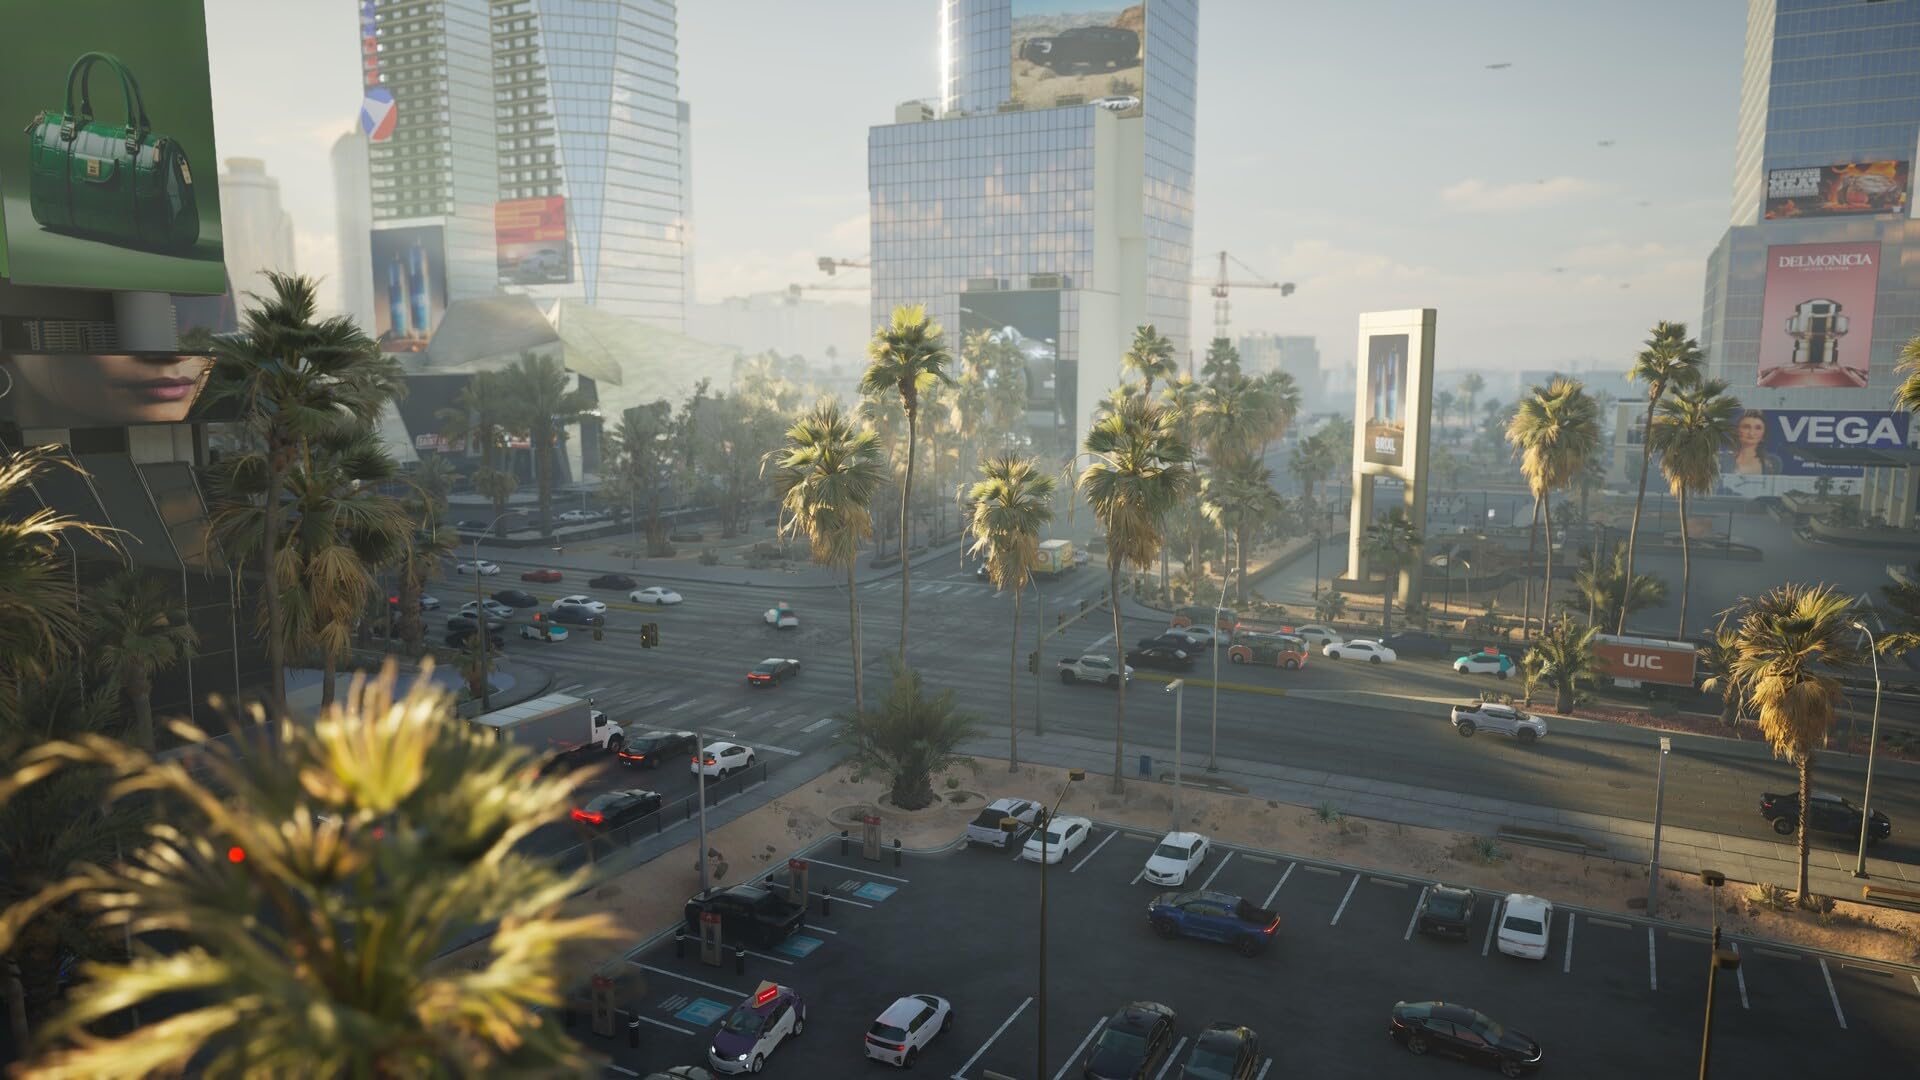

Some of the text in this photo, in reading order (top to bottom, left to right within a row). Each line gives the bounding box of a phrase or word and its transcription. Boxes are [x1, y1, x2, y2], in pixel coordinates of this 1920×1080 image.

[1779, 253, 1872, 268] DELMONICIA
[1778, 415, 1902, 445] VEGA
[1623, 652, 1663, 670] UIC
